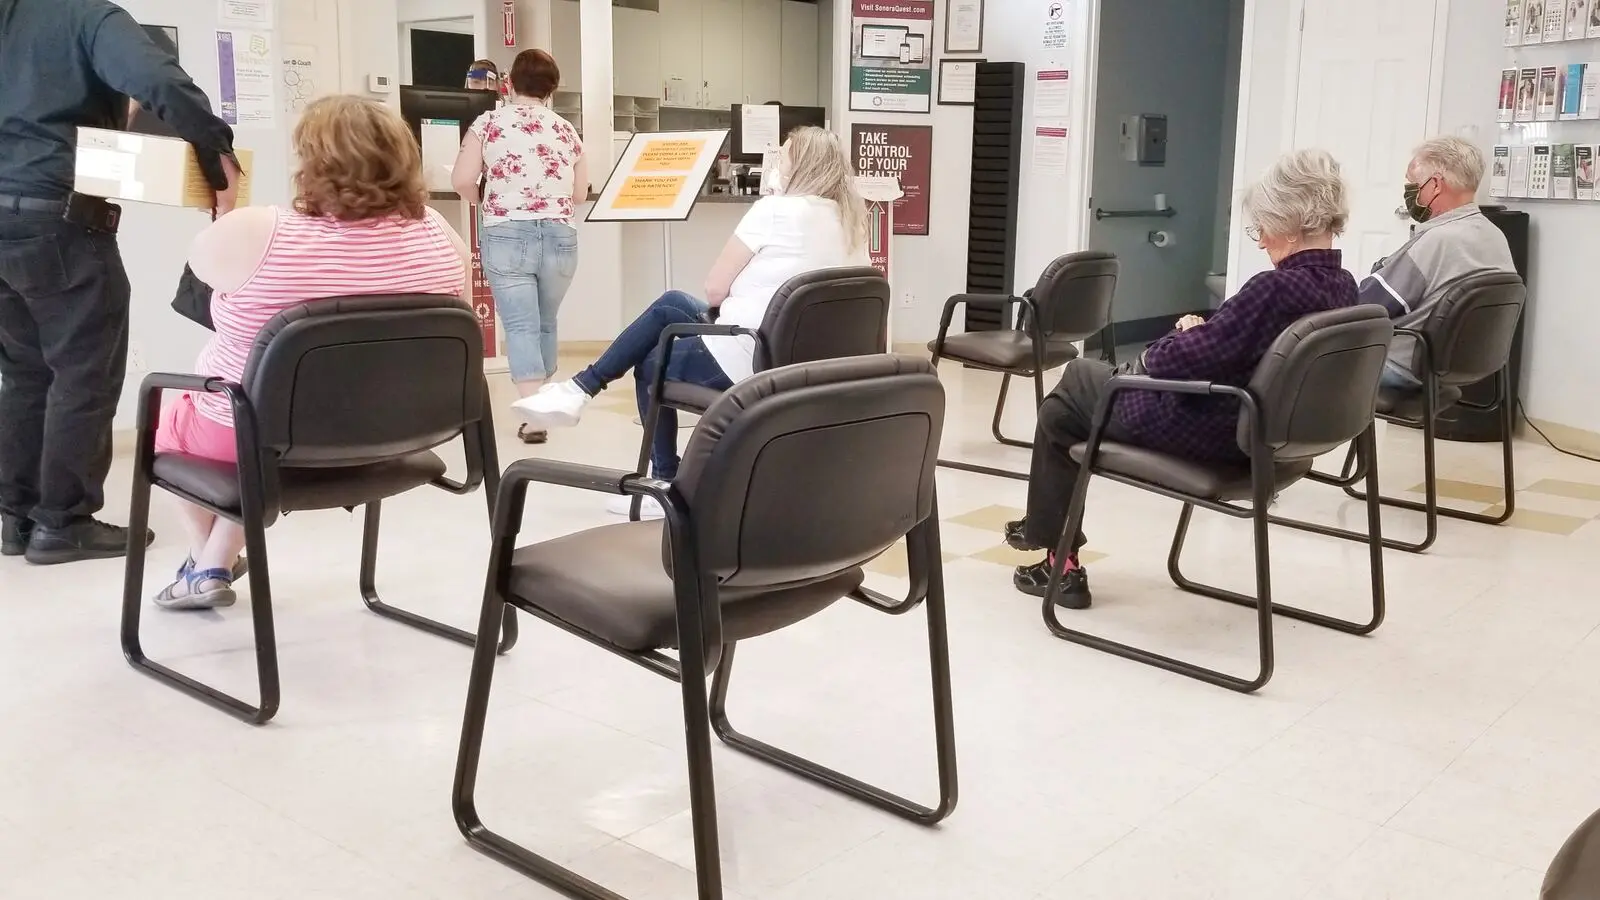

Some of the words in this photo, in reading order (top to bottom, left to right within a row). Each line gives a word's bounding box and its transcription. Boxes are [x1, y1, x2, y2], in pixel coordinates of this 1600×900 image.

[875, 5, 926, 13] SonoraQuest.com
[859, 132, 888, 144] TAKE
[859, 145, 912, 158] CONTROL
[859, 157, 874, 169] OF
[876, 158, 907, 170] YOUR
